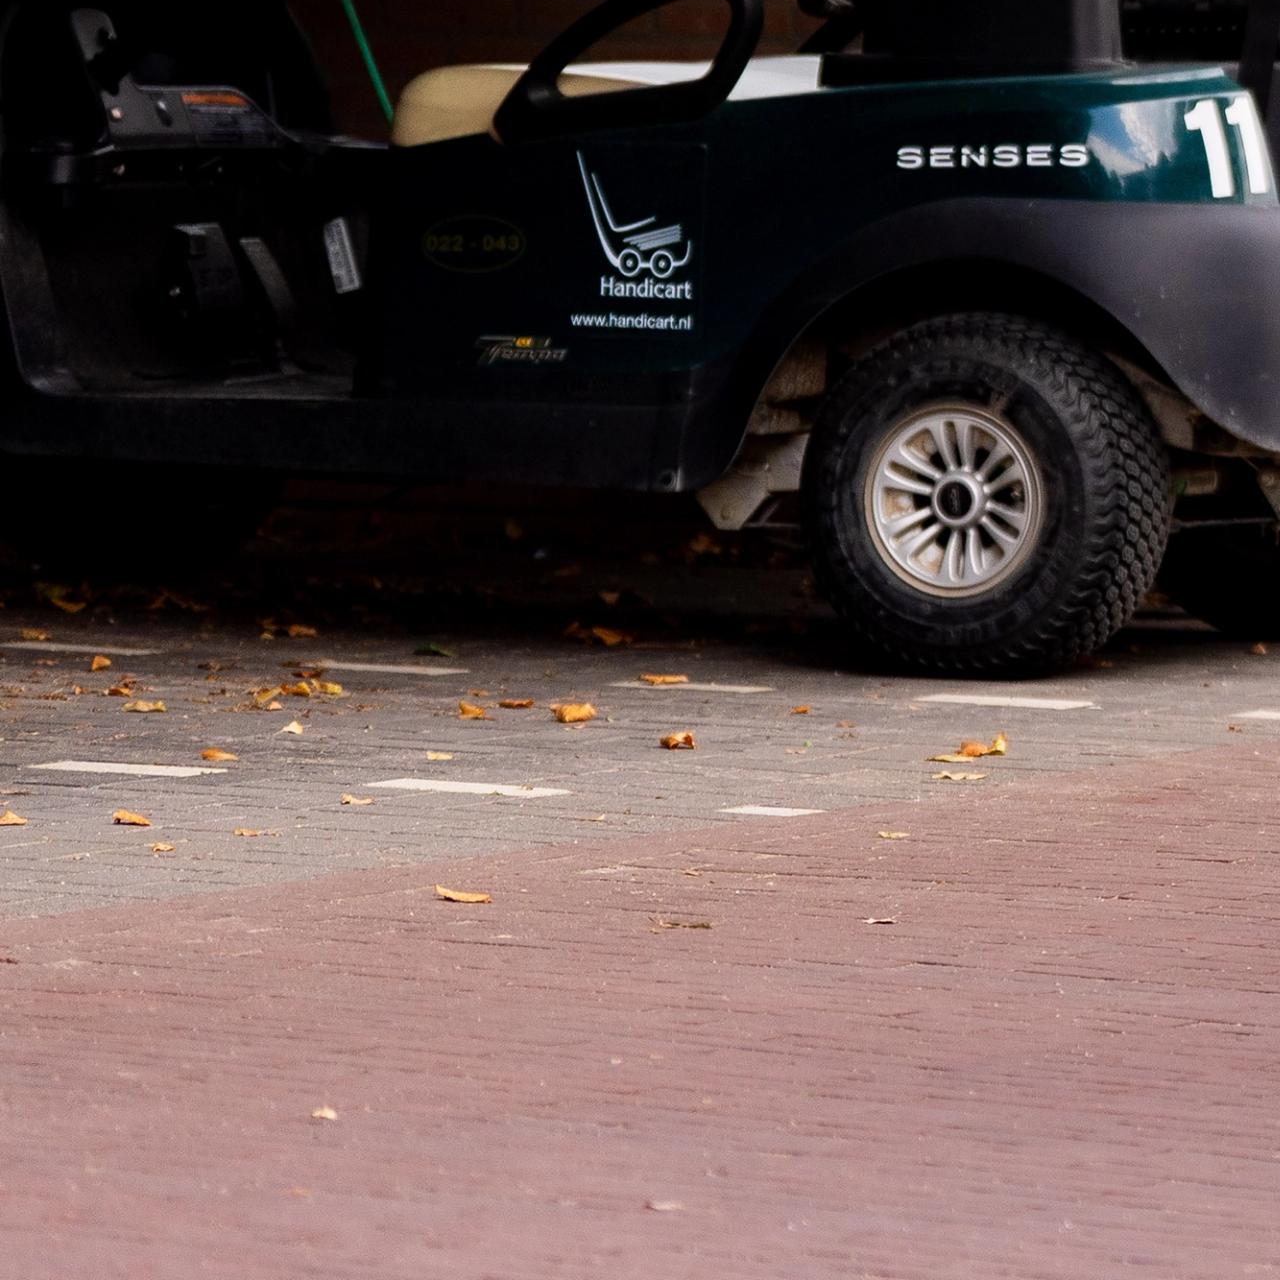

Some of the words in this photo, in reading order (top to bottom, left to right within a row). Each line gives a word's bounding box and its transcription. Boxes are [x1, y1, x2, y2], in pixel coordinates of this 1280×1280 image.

[896, 143, 1091, 170] SENSES
[1184, 100, 1270, 198] 11
[600, 276, 692, 300] Handicart
[570, 312, 692, 330] www.handicart.nl
